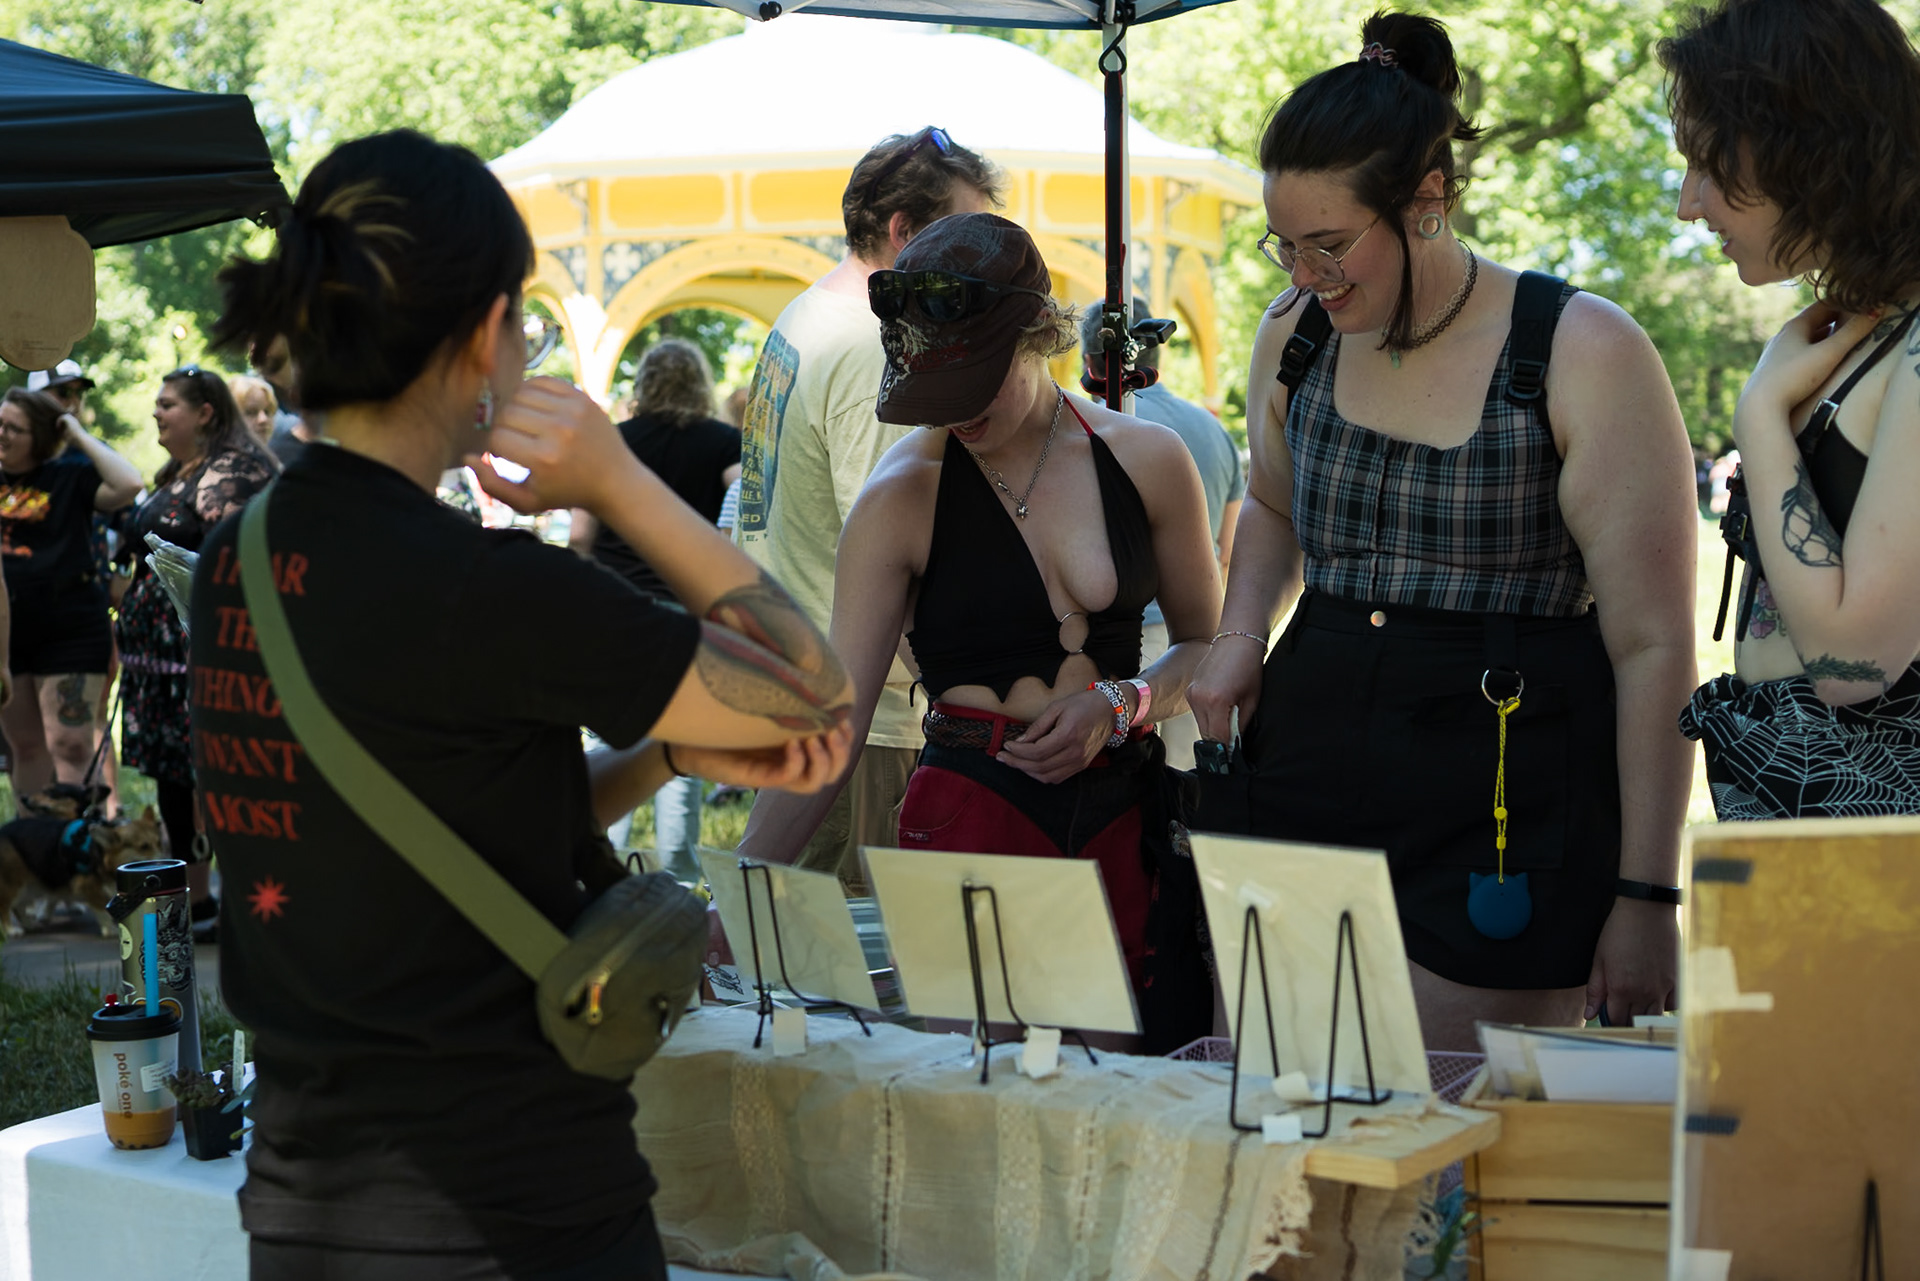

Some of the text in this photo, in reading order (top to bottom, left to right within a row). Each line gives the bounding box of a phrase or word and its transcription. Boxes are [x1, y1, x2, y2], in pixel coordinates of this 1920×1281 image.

[215, 607, 259, 651] TH
[193, 667, 281, 717] THING
[206, 792, 302, 841] MOST
[114, 1053, 132, 1088] poké
